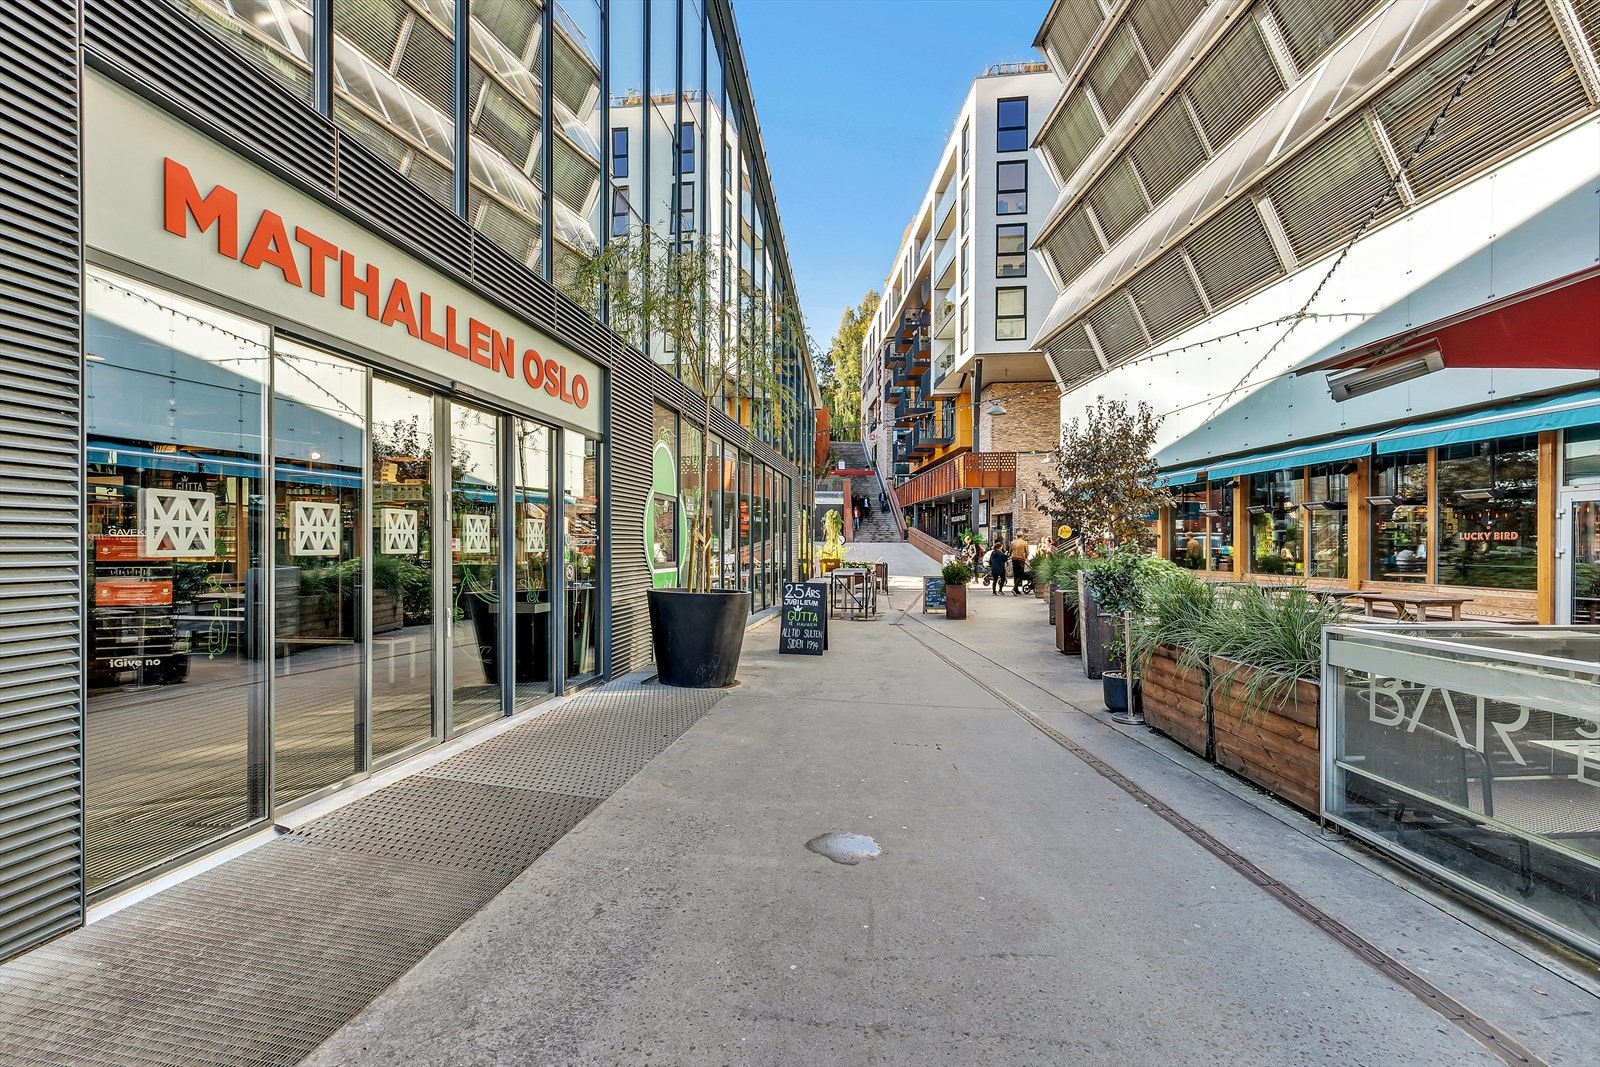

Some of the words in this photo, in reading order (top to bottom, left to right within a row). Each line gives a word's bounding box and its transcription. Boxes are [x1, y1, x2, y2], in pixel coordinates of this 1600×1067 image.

[163, 156, 514, 379] MATHALLEN
[522, 349, 589, 410] OSLO
[1459, 532, 1491, 541] LUCKY
[1493, 531, 1519, 541] BIRD
[784, 583, 805, 599] 25
[805, 586, 821, 599] ÅRS
[783, 598, 819, 607] JUBILEUM
[787, 610, 818, 623] GUTTA
[781, 627, 801, 638] ALLTID
[803, 628, 823, 639] SULTEN
[787, 637, 804, 649] SIDEN
[806, 639, 819, 651] 1994
[109, 659, 142, 668] iGive
